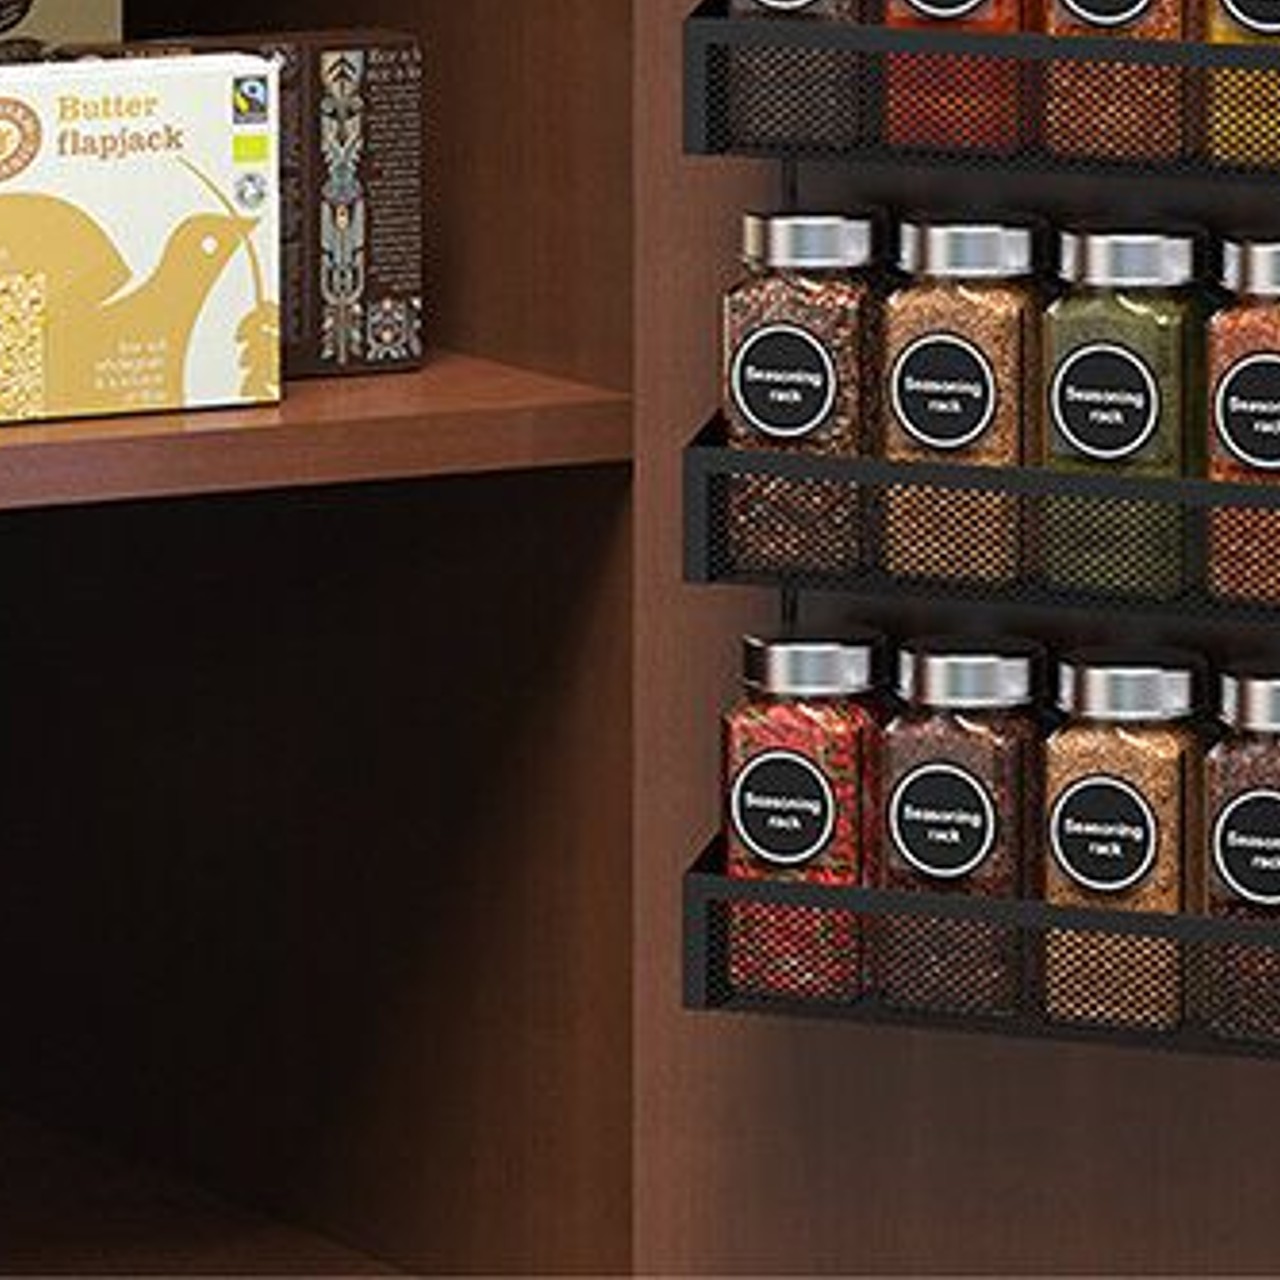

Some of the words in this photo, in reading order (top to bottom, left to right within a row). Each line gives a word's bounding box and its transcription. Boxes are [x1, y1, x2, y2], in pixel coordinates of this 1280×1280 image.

[57, 93, 160, 122] Butter
[57, 123, 185, 160] flapjack
[745, 365, 823, 388] Seasoning
[904, 376, 983, 399] Seasoning
[768, 389, 802, 403] rack
[927, 399, 962, 413] rack
[1065, 385, 1145, 409] Seasoning
[1089, 410, 1124, 424] rack
[744, 791, 822, 816] Seasoning
[767, 814, 802, 829] rack
[903, 804, 982, 829] Seasoning
[927, 828, 960, 843] rack
[1064, 818, 1144, 842] Seasoning
[1088, 842, 1122, 856] rack
